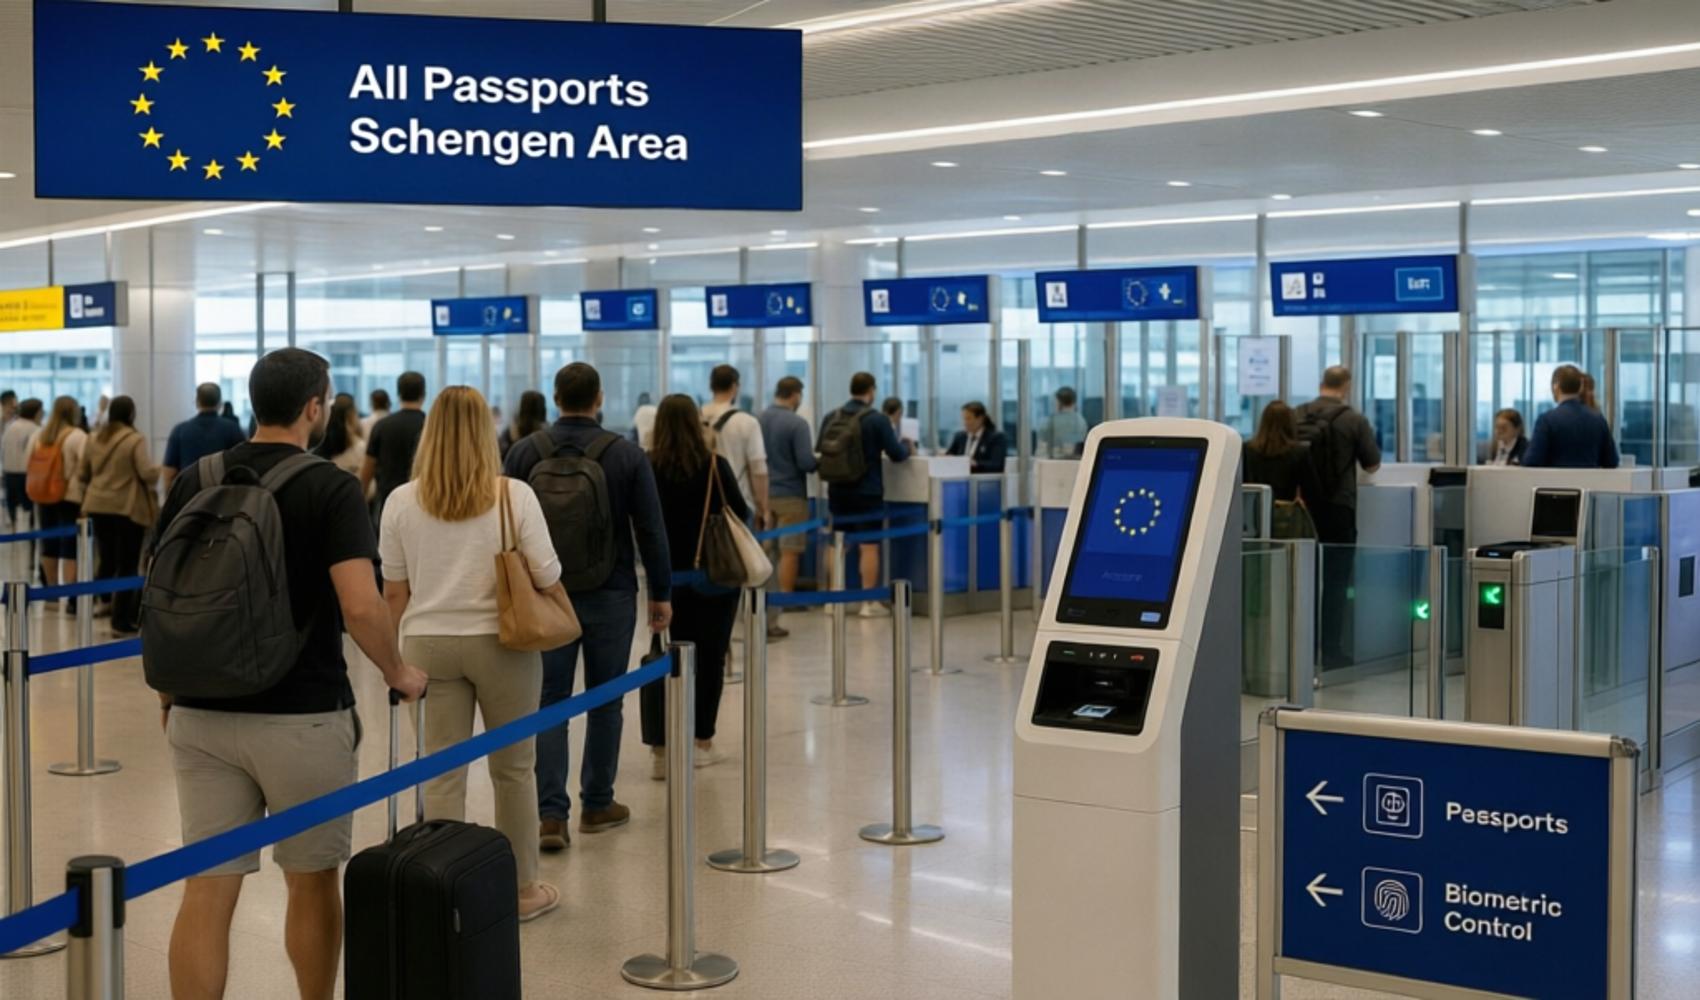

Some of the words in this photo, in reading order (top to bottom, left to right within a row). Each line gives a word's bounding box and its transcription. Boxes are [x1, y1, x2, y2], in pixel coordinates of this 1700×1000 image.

[349, 64, 409, 100] All
[424, 66, 649, 114] Passports
[350, 117, 575, 166] Schengen
[587, 124, 688, 161] Area
[1445, 882, 1562, 917] Biometric
[1444, 911, 1532, 941] Control
